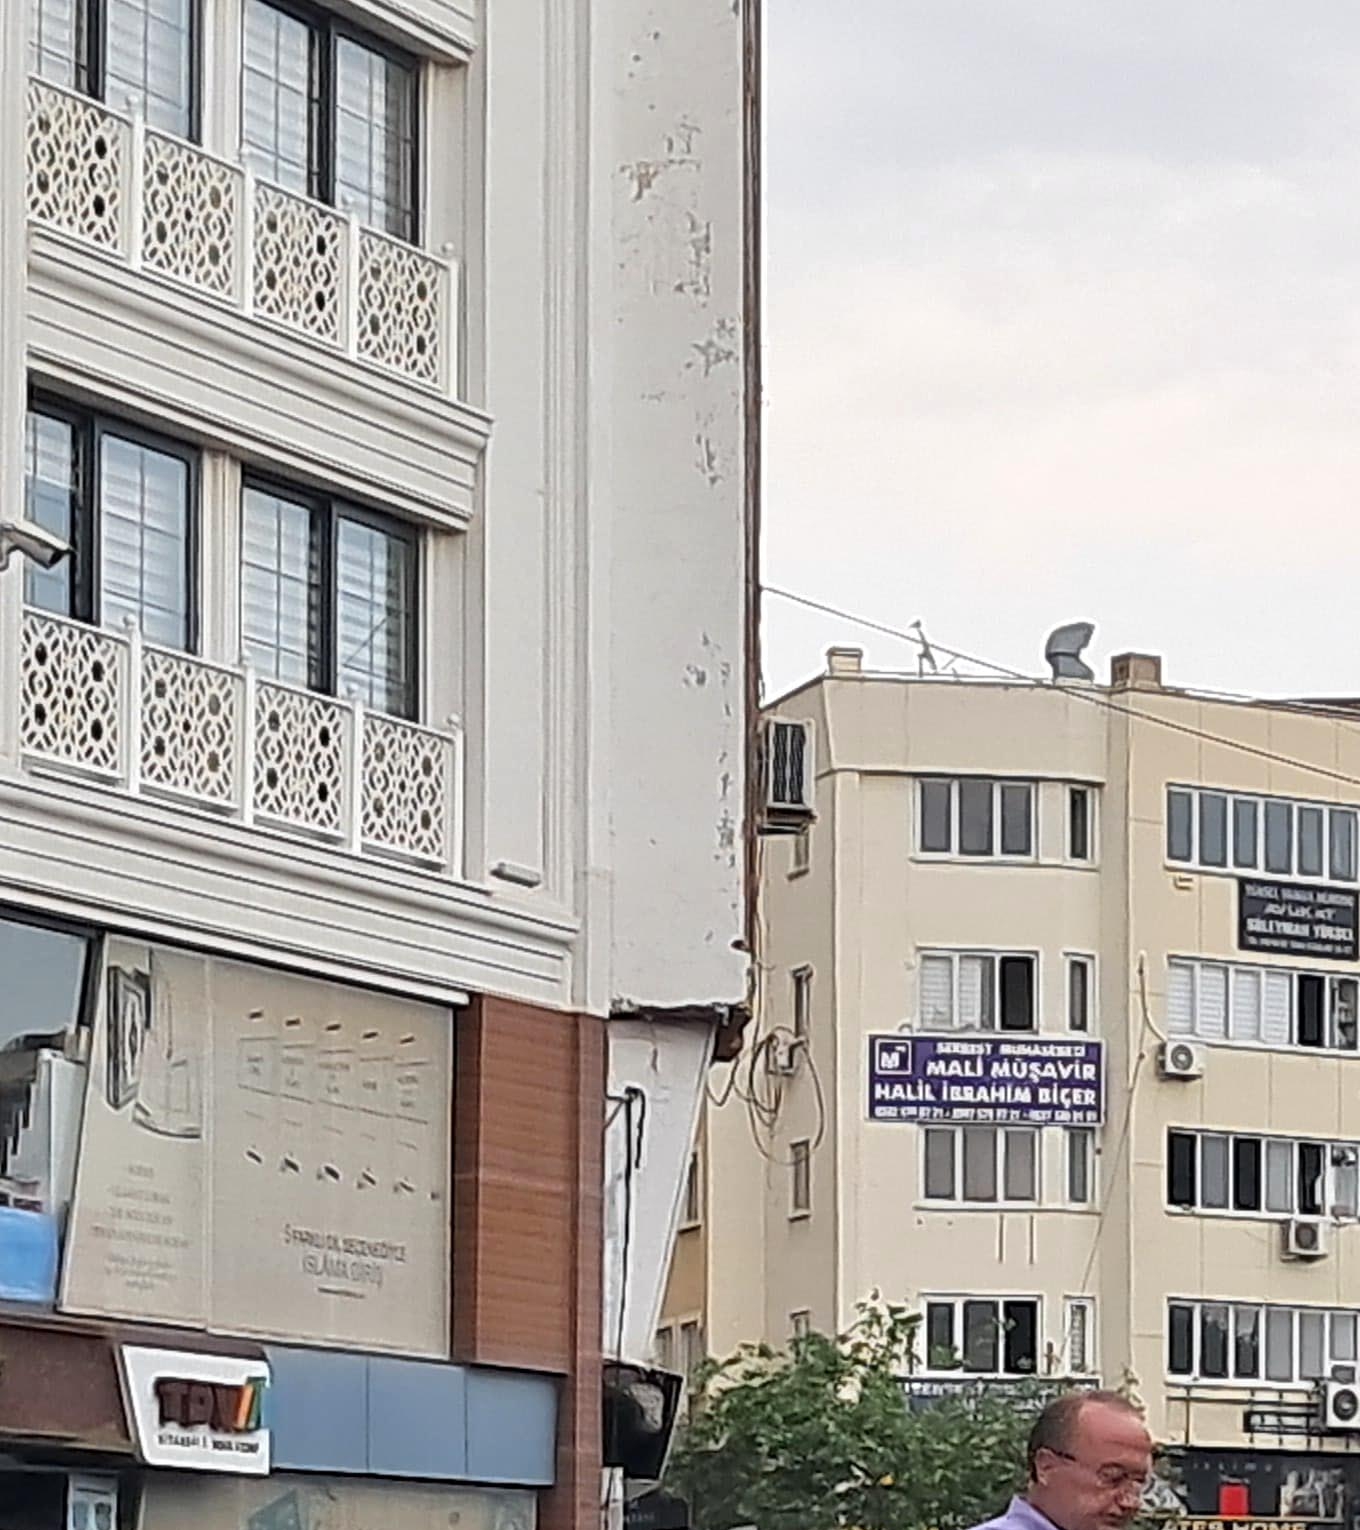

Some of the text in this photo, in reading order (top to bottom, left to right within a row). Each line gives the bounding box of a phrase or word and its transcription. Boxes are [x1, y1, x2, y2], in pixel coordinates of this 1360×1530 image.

[926, 1055, 1096, 1083] MALİ MÜŞAVİR
[875, 1079, 1097, 1108] HALİL İBRAHİM BİÇER
